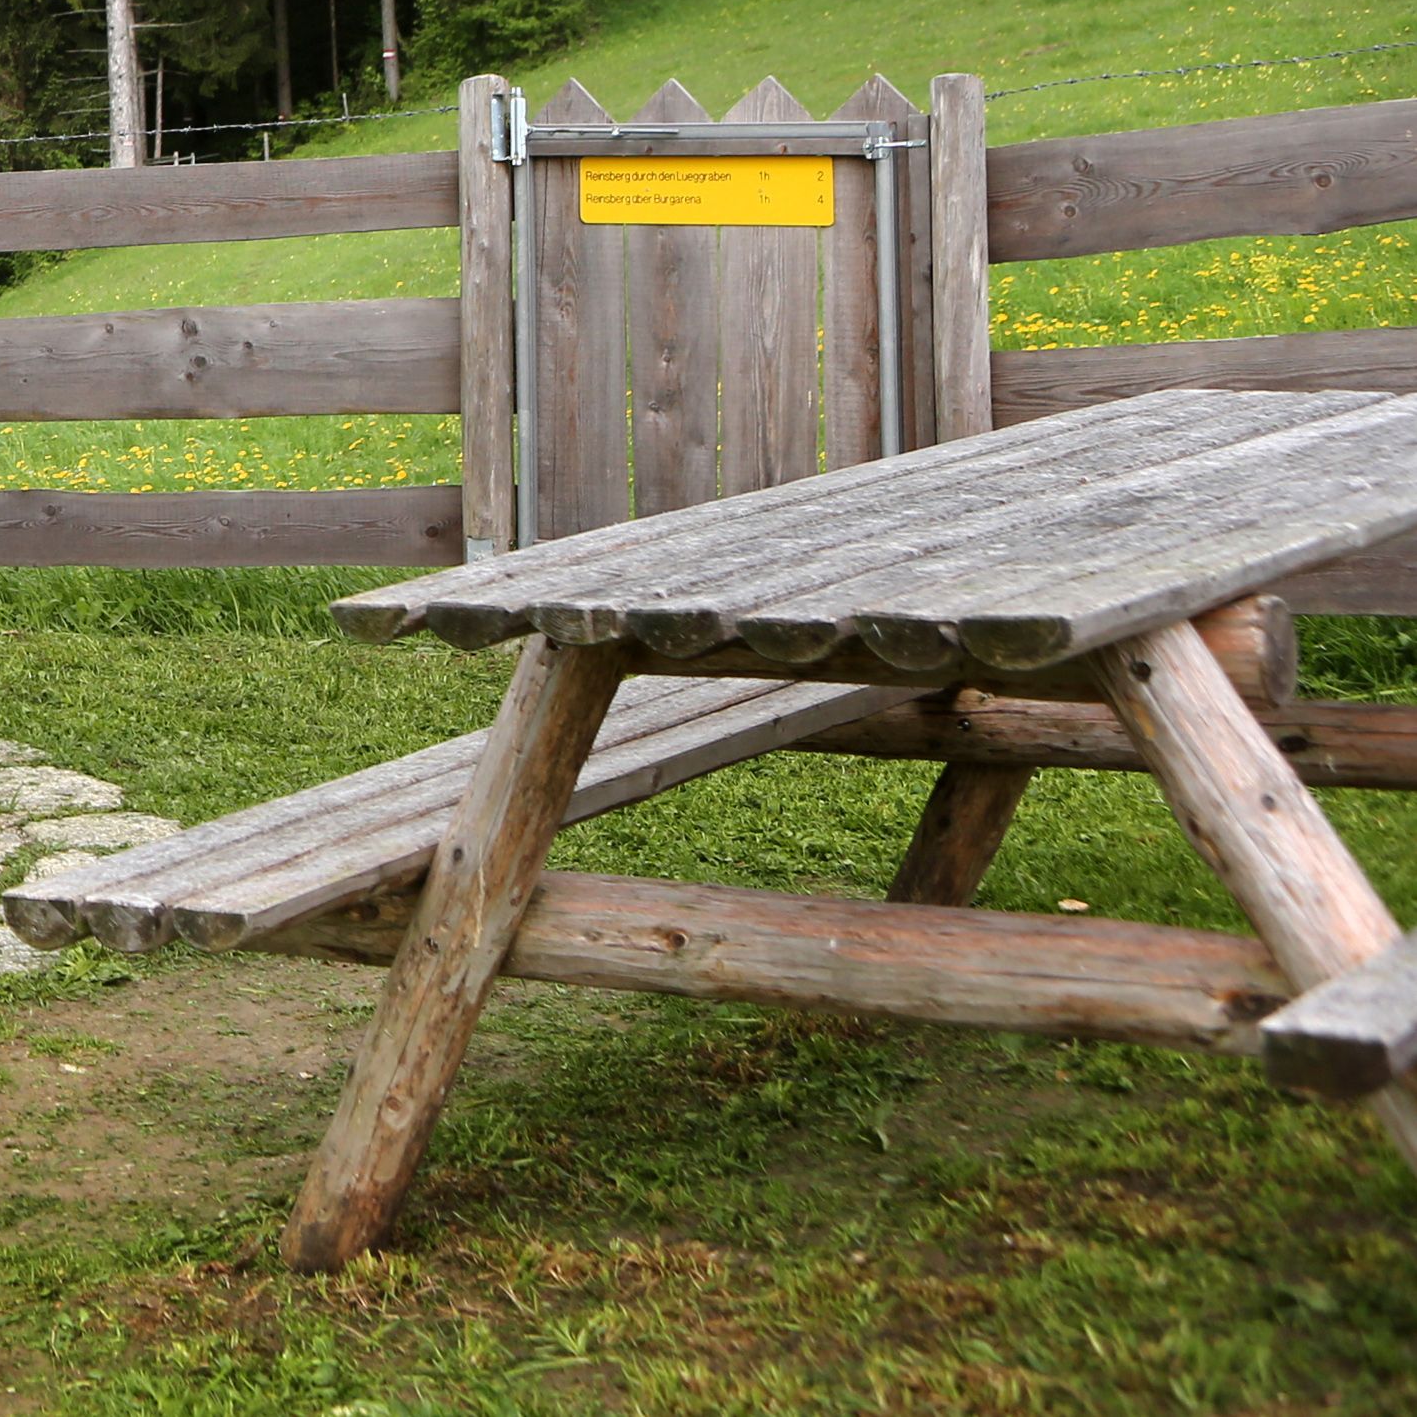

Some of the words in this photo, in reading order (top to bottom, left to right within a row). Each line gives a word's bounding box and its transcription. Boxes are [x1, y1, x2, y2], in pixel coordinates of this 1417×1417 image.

[585, 170, 631, 183] Reinsberg
[631, 171, 657, 182] durch
[658, 171, 676, 182] den
[676, 170, 732, 184] Lueggraben
[758, 170, 770, 182] 1h
[816, 170, 825, 182] 2
[585, 193, 631, 206] Reinsberg
[653, 194, 702, 206] Burgarena
[758, 194, 771, 205] 1h
[816, 194, 825, 205] 4
